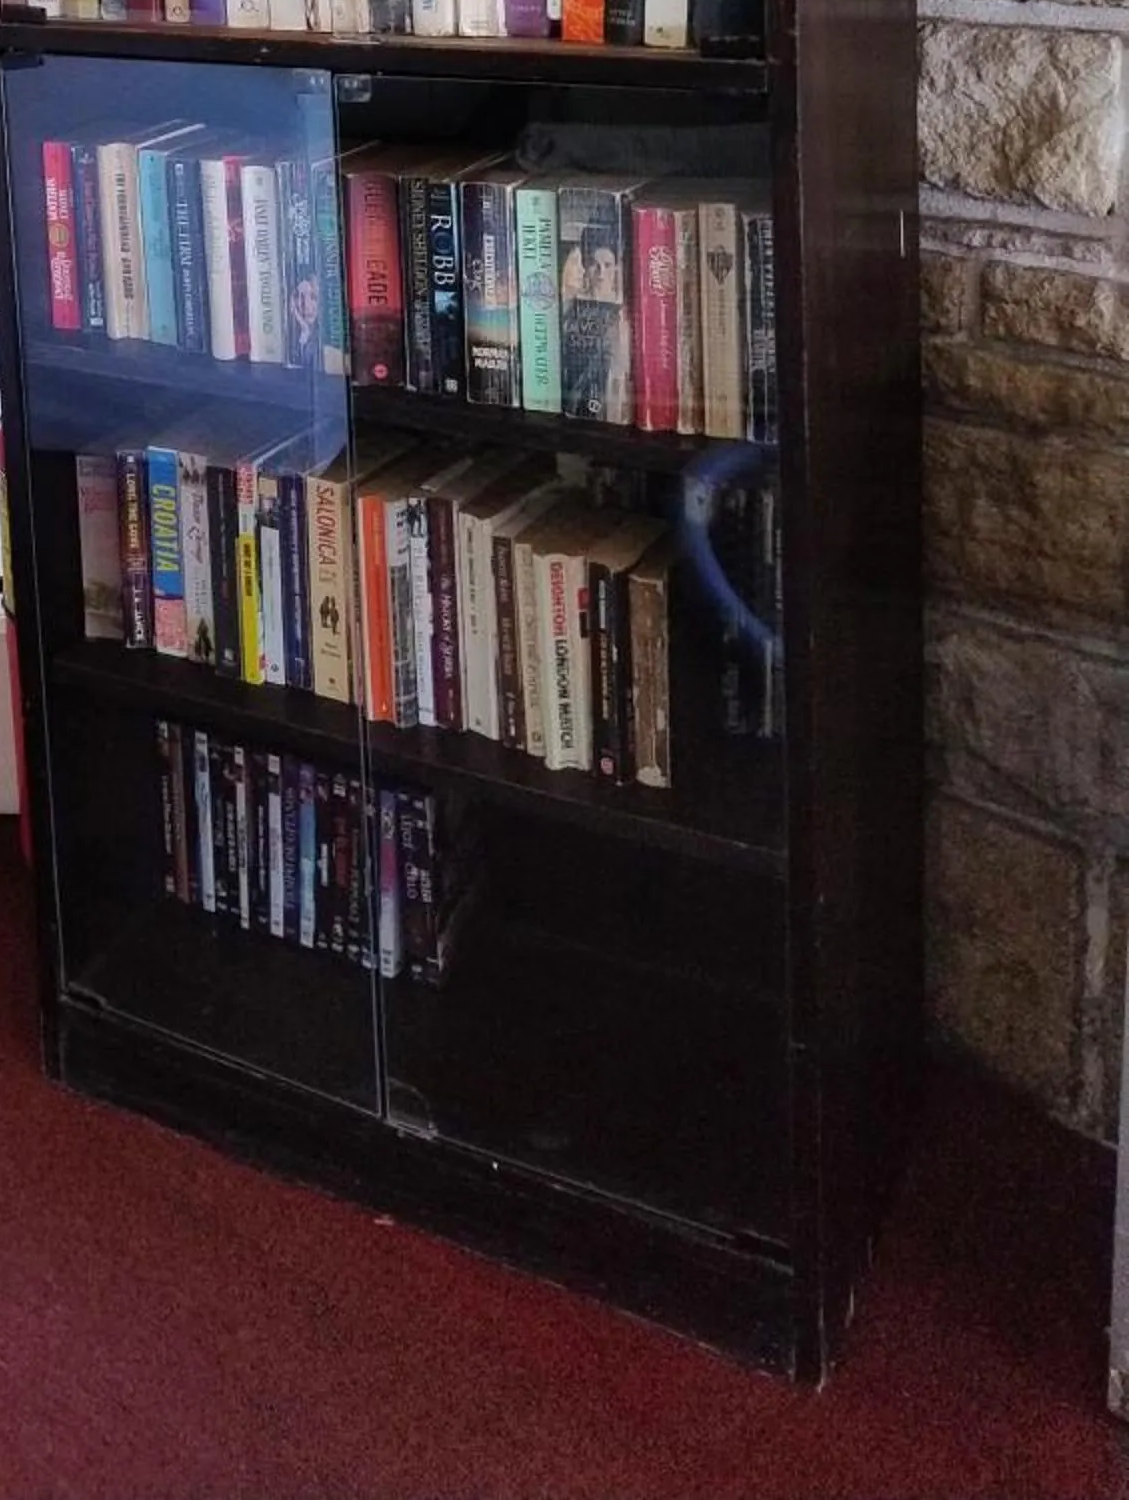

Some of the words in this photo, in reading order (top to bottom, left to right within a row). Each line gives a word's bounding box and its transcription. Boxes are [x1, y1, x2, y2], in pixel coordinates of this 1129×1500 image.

[430, 214, 456, 286] ROBB
[152, 483, 180, 572] CROATIA
[316, 485, 337, 566] SALONICA
[551, 561, 568, 637] DEIGHTON
[554, 638, 571, 699] LONDON
